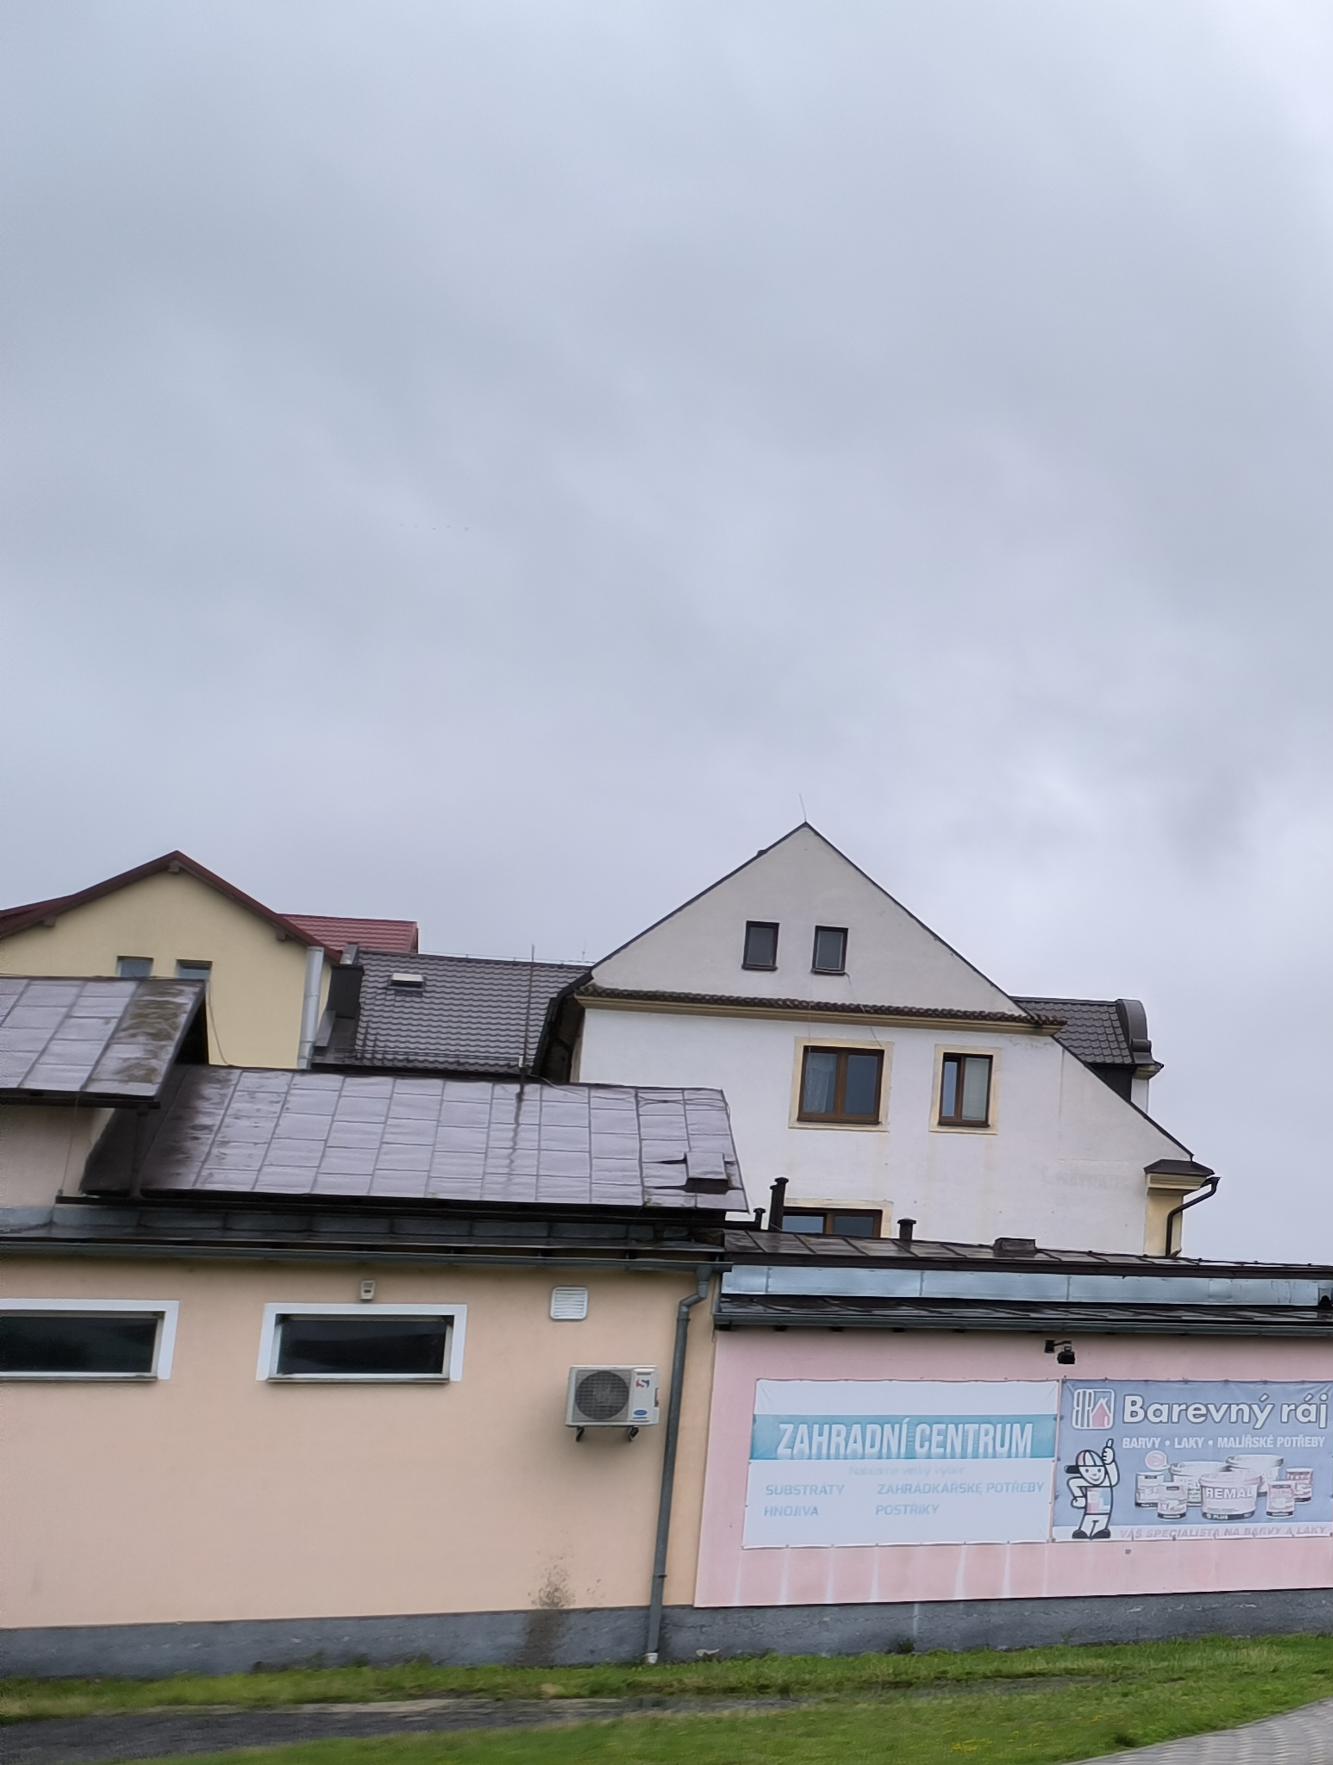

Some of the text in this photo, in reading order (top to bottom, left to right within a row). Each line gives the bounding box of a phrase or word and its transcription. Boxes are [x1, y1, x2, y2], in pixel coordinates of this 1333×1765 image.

[1123, 1394, 1274, 1429] Barevný
[1280, 1394, 1328, 1429] ráj
[777, 1418, 1033, 1459] ZAHRADNÍ CENTRUM
[1122, 1434, 1326, 1449] BARVY LAKY MALÍŘSKÉ POTŘEBY
[763, 1505, 819, 1517] HNOJIVA
